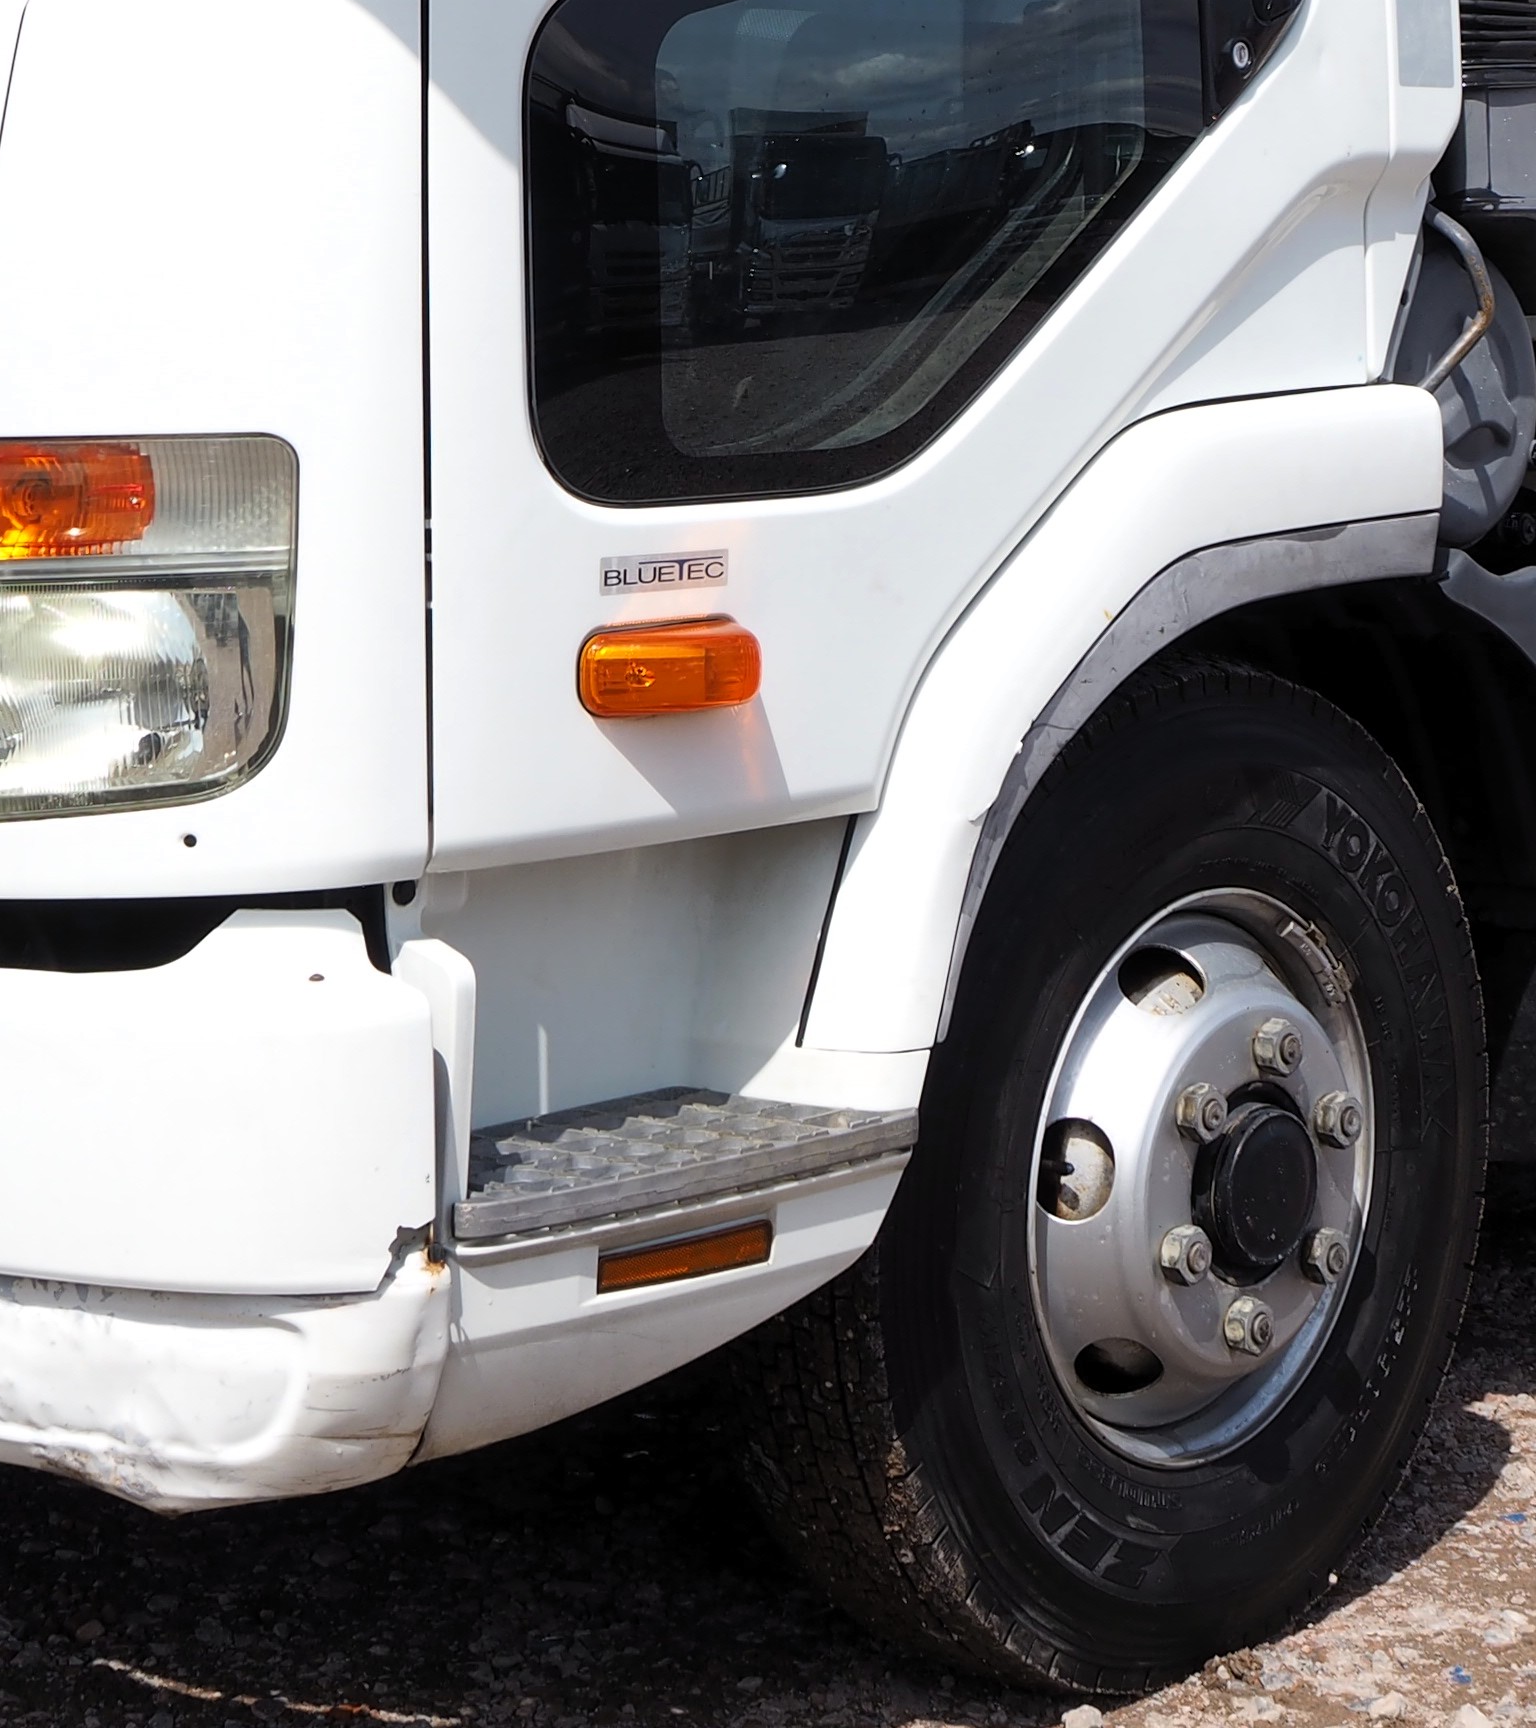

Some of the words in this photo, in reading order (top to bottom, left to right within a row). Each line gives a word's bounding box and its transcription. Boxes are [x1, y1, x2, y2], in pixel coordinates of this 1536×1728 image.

[603, 555, 724, 588] BLUETEC
[1322, 793, 1452, 1114] YOKOHAMA
[1020, 1475, 1159, 1589] ZEN
